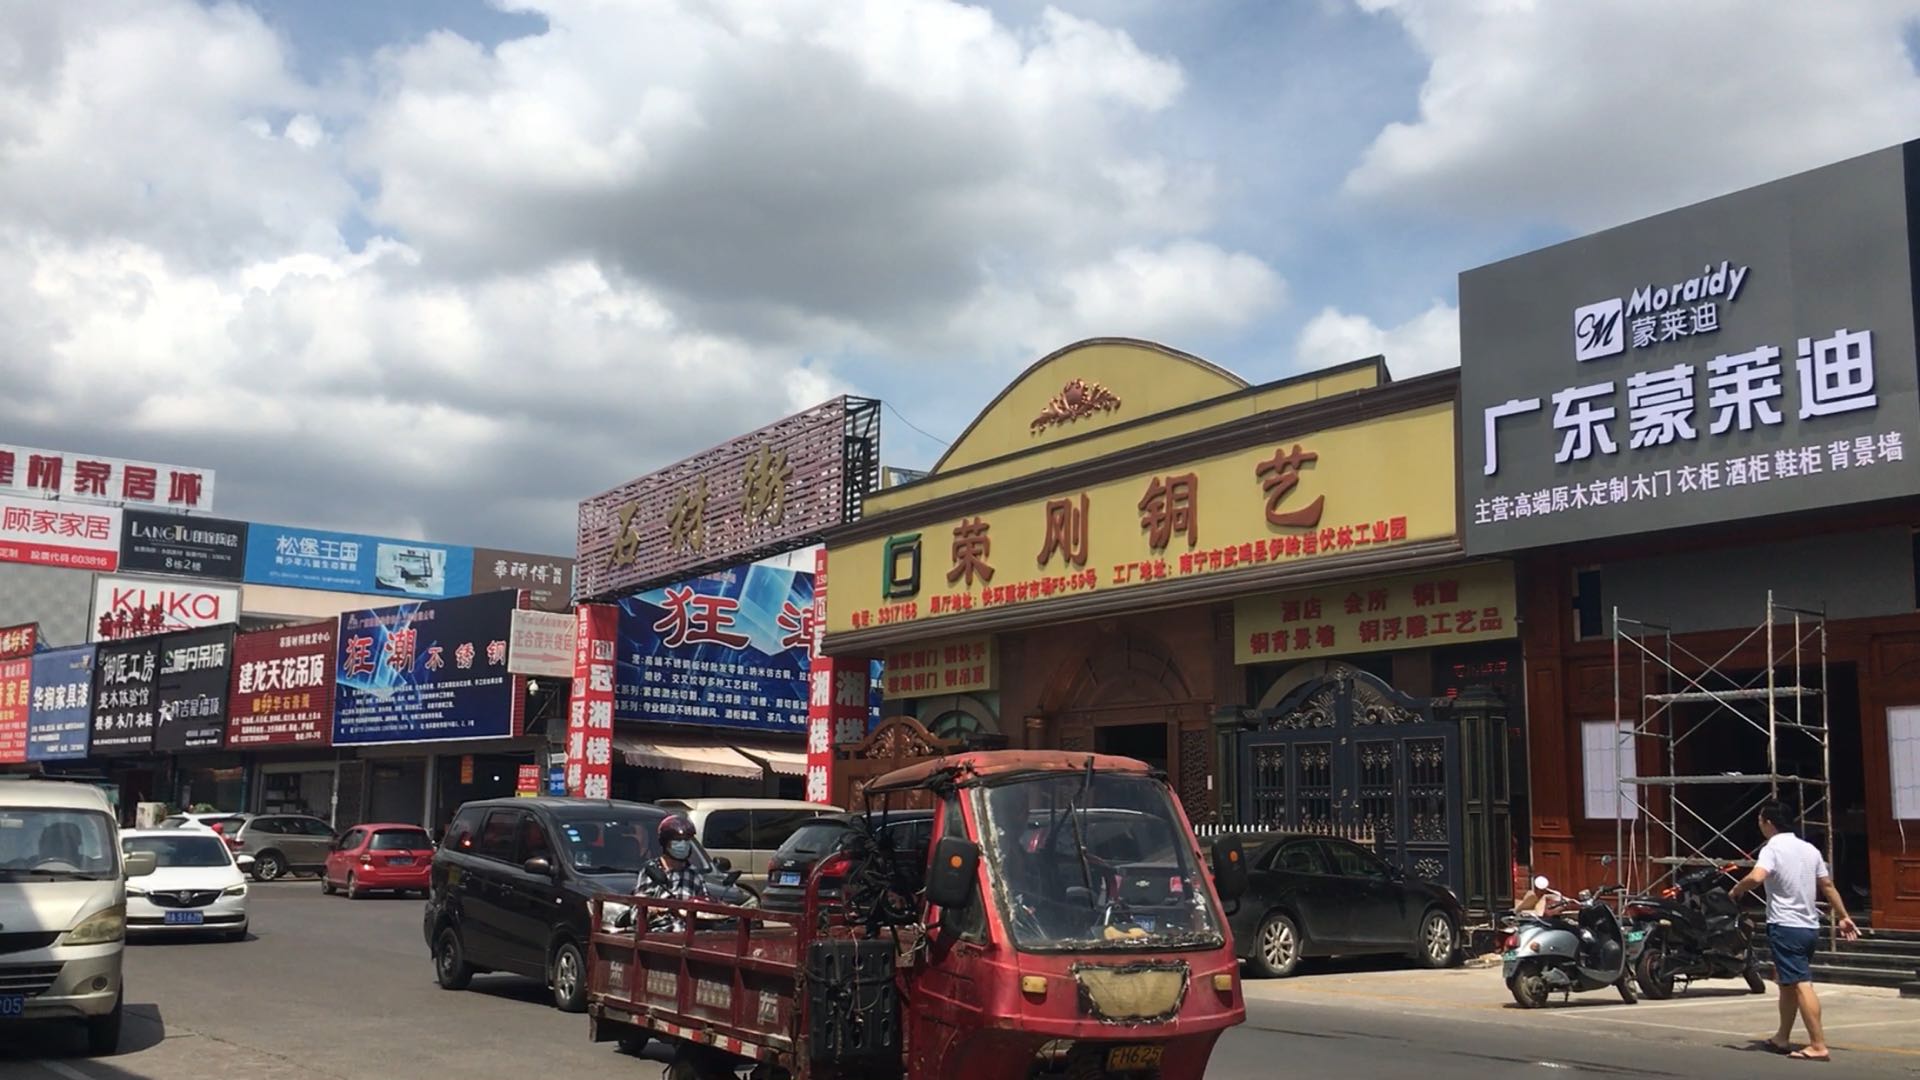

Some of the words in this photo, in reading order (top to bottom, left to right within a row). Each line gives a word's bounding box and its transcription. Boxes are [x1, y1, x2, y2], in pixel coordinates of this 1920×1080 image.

[1625, 261, 1748, 317] Moraidy
[1632, 302, 1719, 348] 蒙莱迪
[1484, 328, 1877, 476] 广东蒙莱迪
[1631, 471, 1672, 500] 木门
[1676, 462, 1721, 492] 衣柜
[1725, 453, 1771, 486] 酒柜
[1774, 445, 1822, 478] 鞋柜
[1826, 431, 1903, 471] 背景墙
[2, 507, 111, 541] 顾家家居
[946, 444, 1325, 586] 荣刚铜艺
[276, 534, 358, 562] 松堡王国
[1344, 588, 1388, 614] 会所
[238, 654, 325, 694] 建龙天花吊顶
[33, 682, 89, 712] 华润家具漆
[0, 998, 21, 1014] 05
